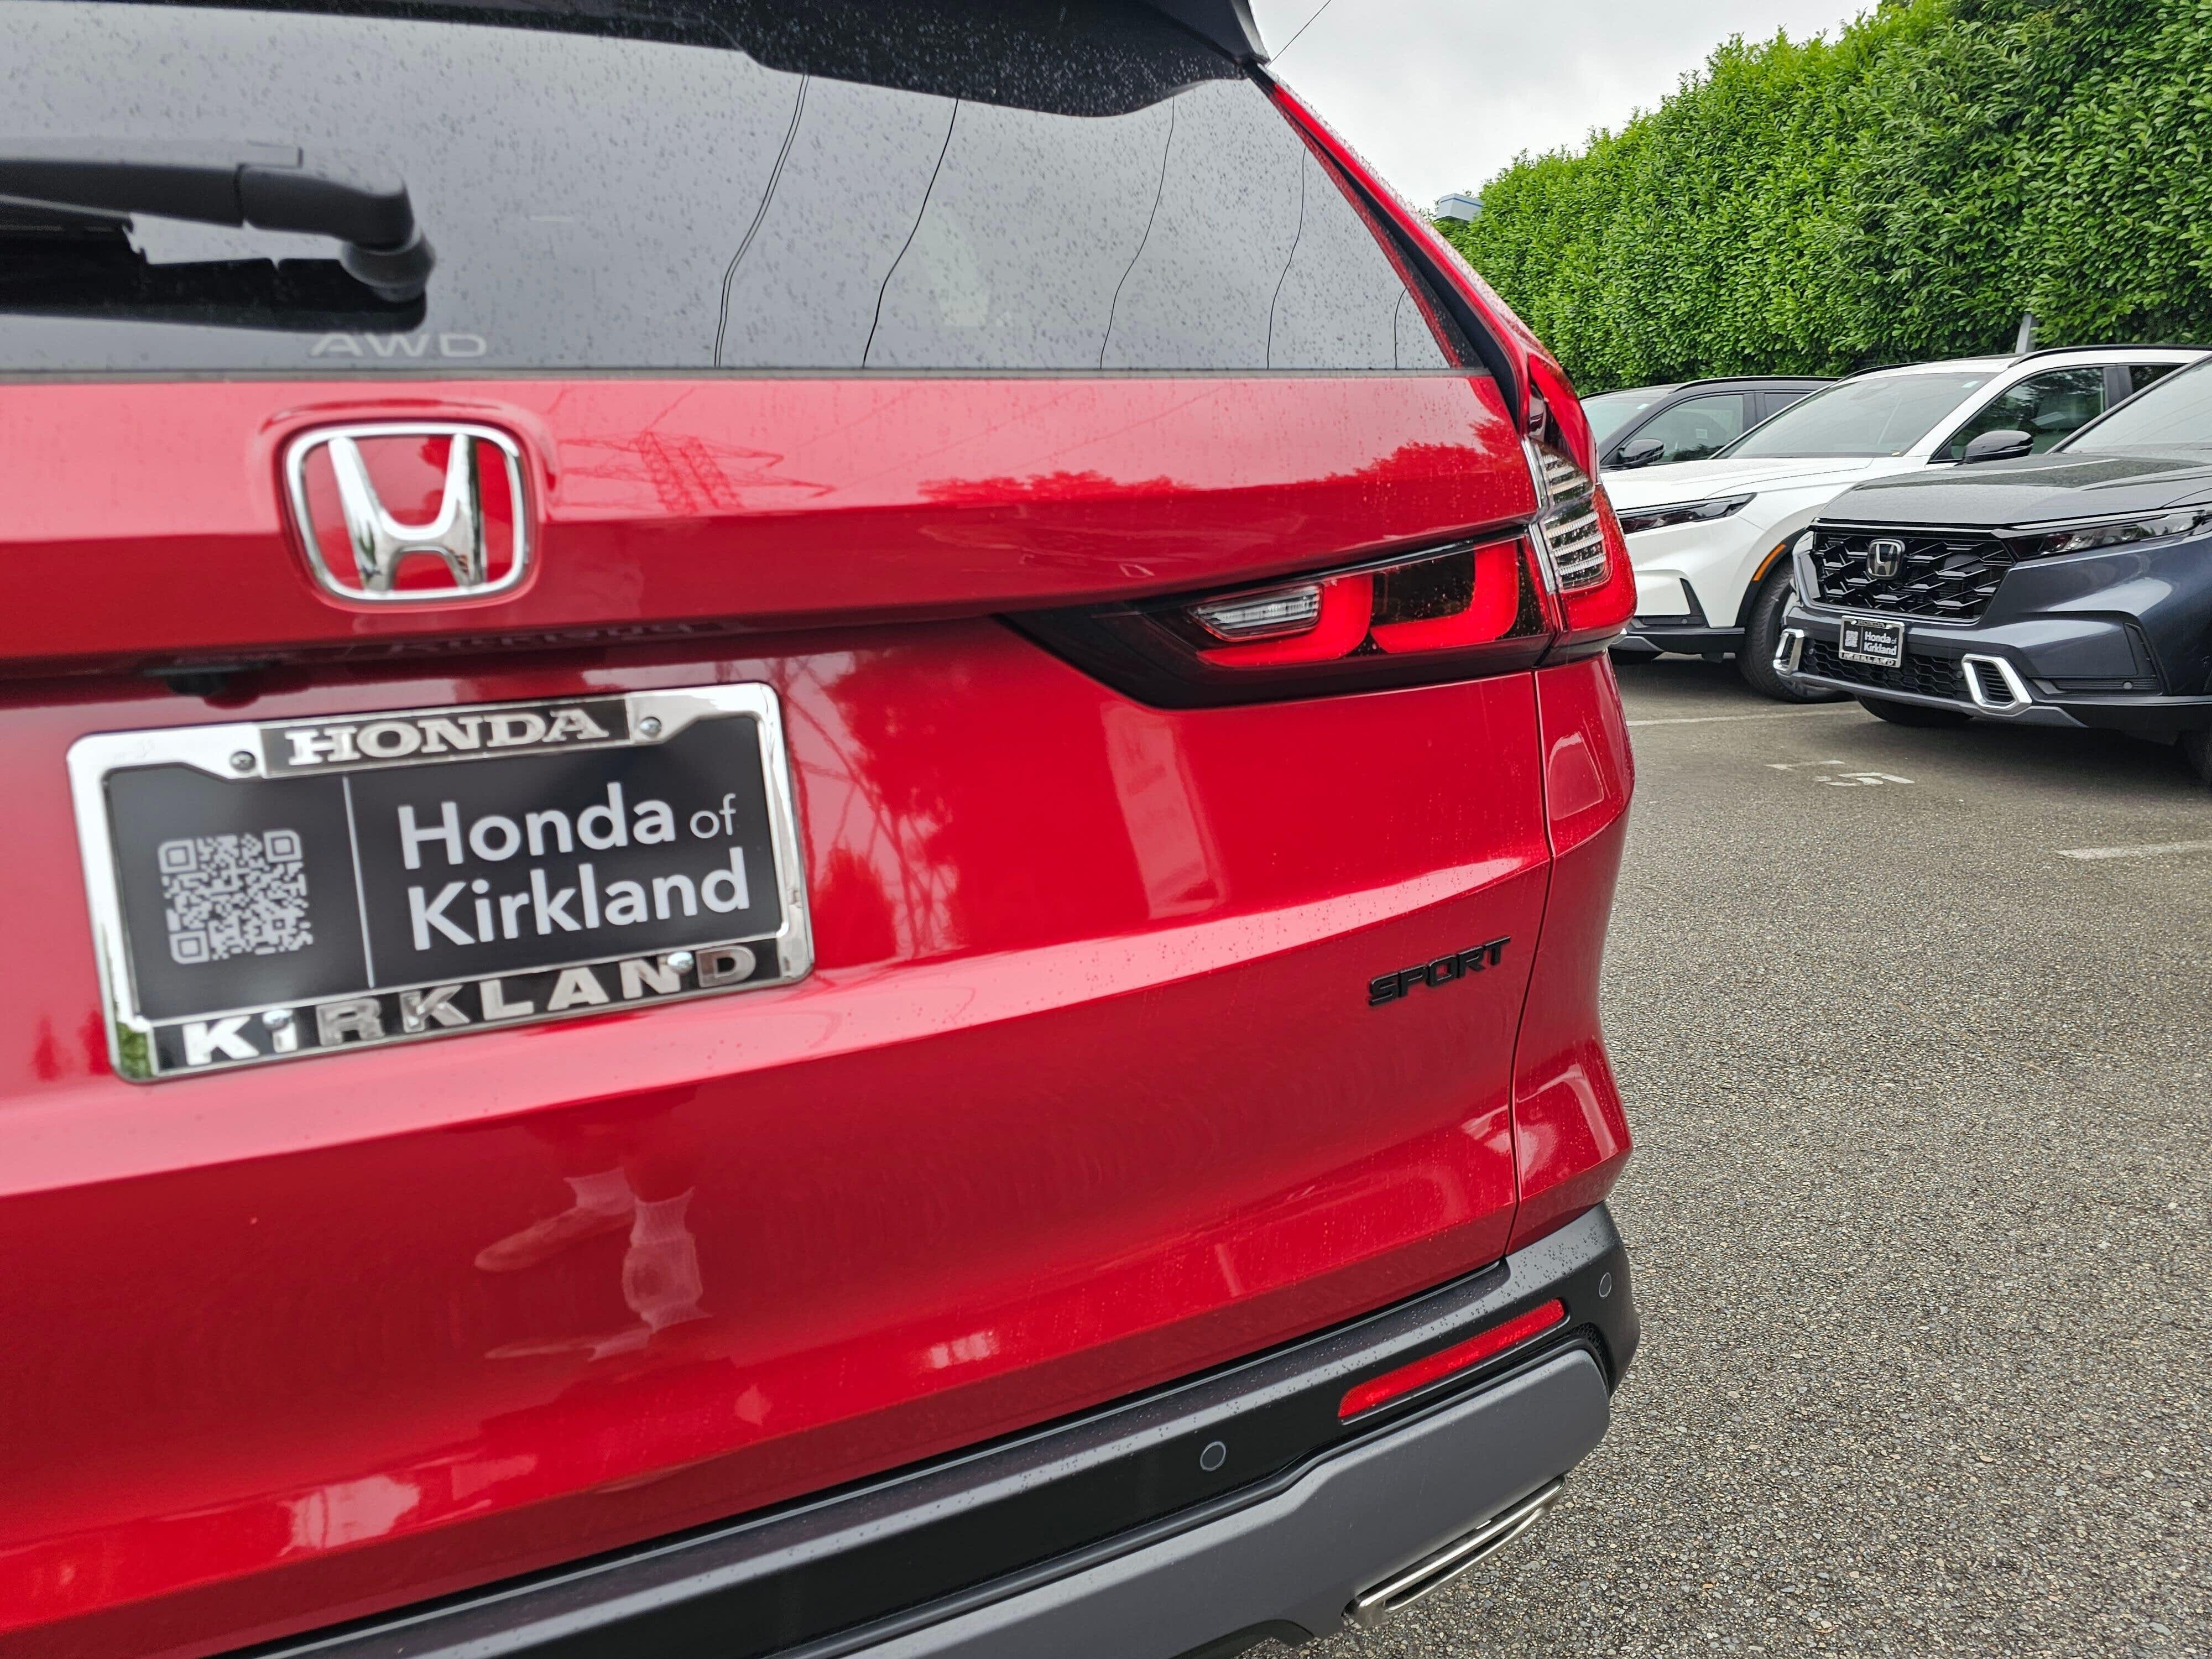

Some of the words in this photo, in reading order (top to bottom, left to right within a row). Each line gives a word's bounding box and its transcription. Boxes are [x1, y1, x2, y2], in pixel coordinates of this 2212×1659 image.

[310, 332, 488, 358] AWD
[1864, 641, 1897, 655] Kirkland
[1865, 631, 1891, 644] Honda
[284, 708, 609, 766] HONDA
[398, 781, 676, 870] Honda
[690, 792, 737, 839] of
[408, 847, 750, 951] Kirkland
[1368, 936, 1511, 1006] SPORT
[182, 945, 757, 1066] KIRKLAND
